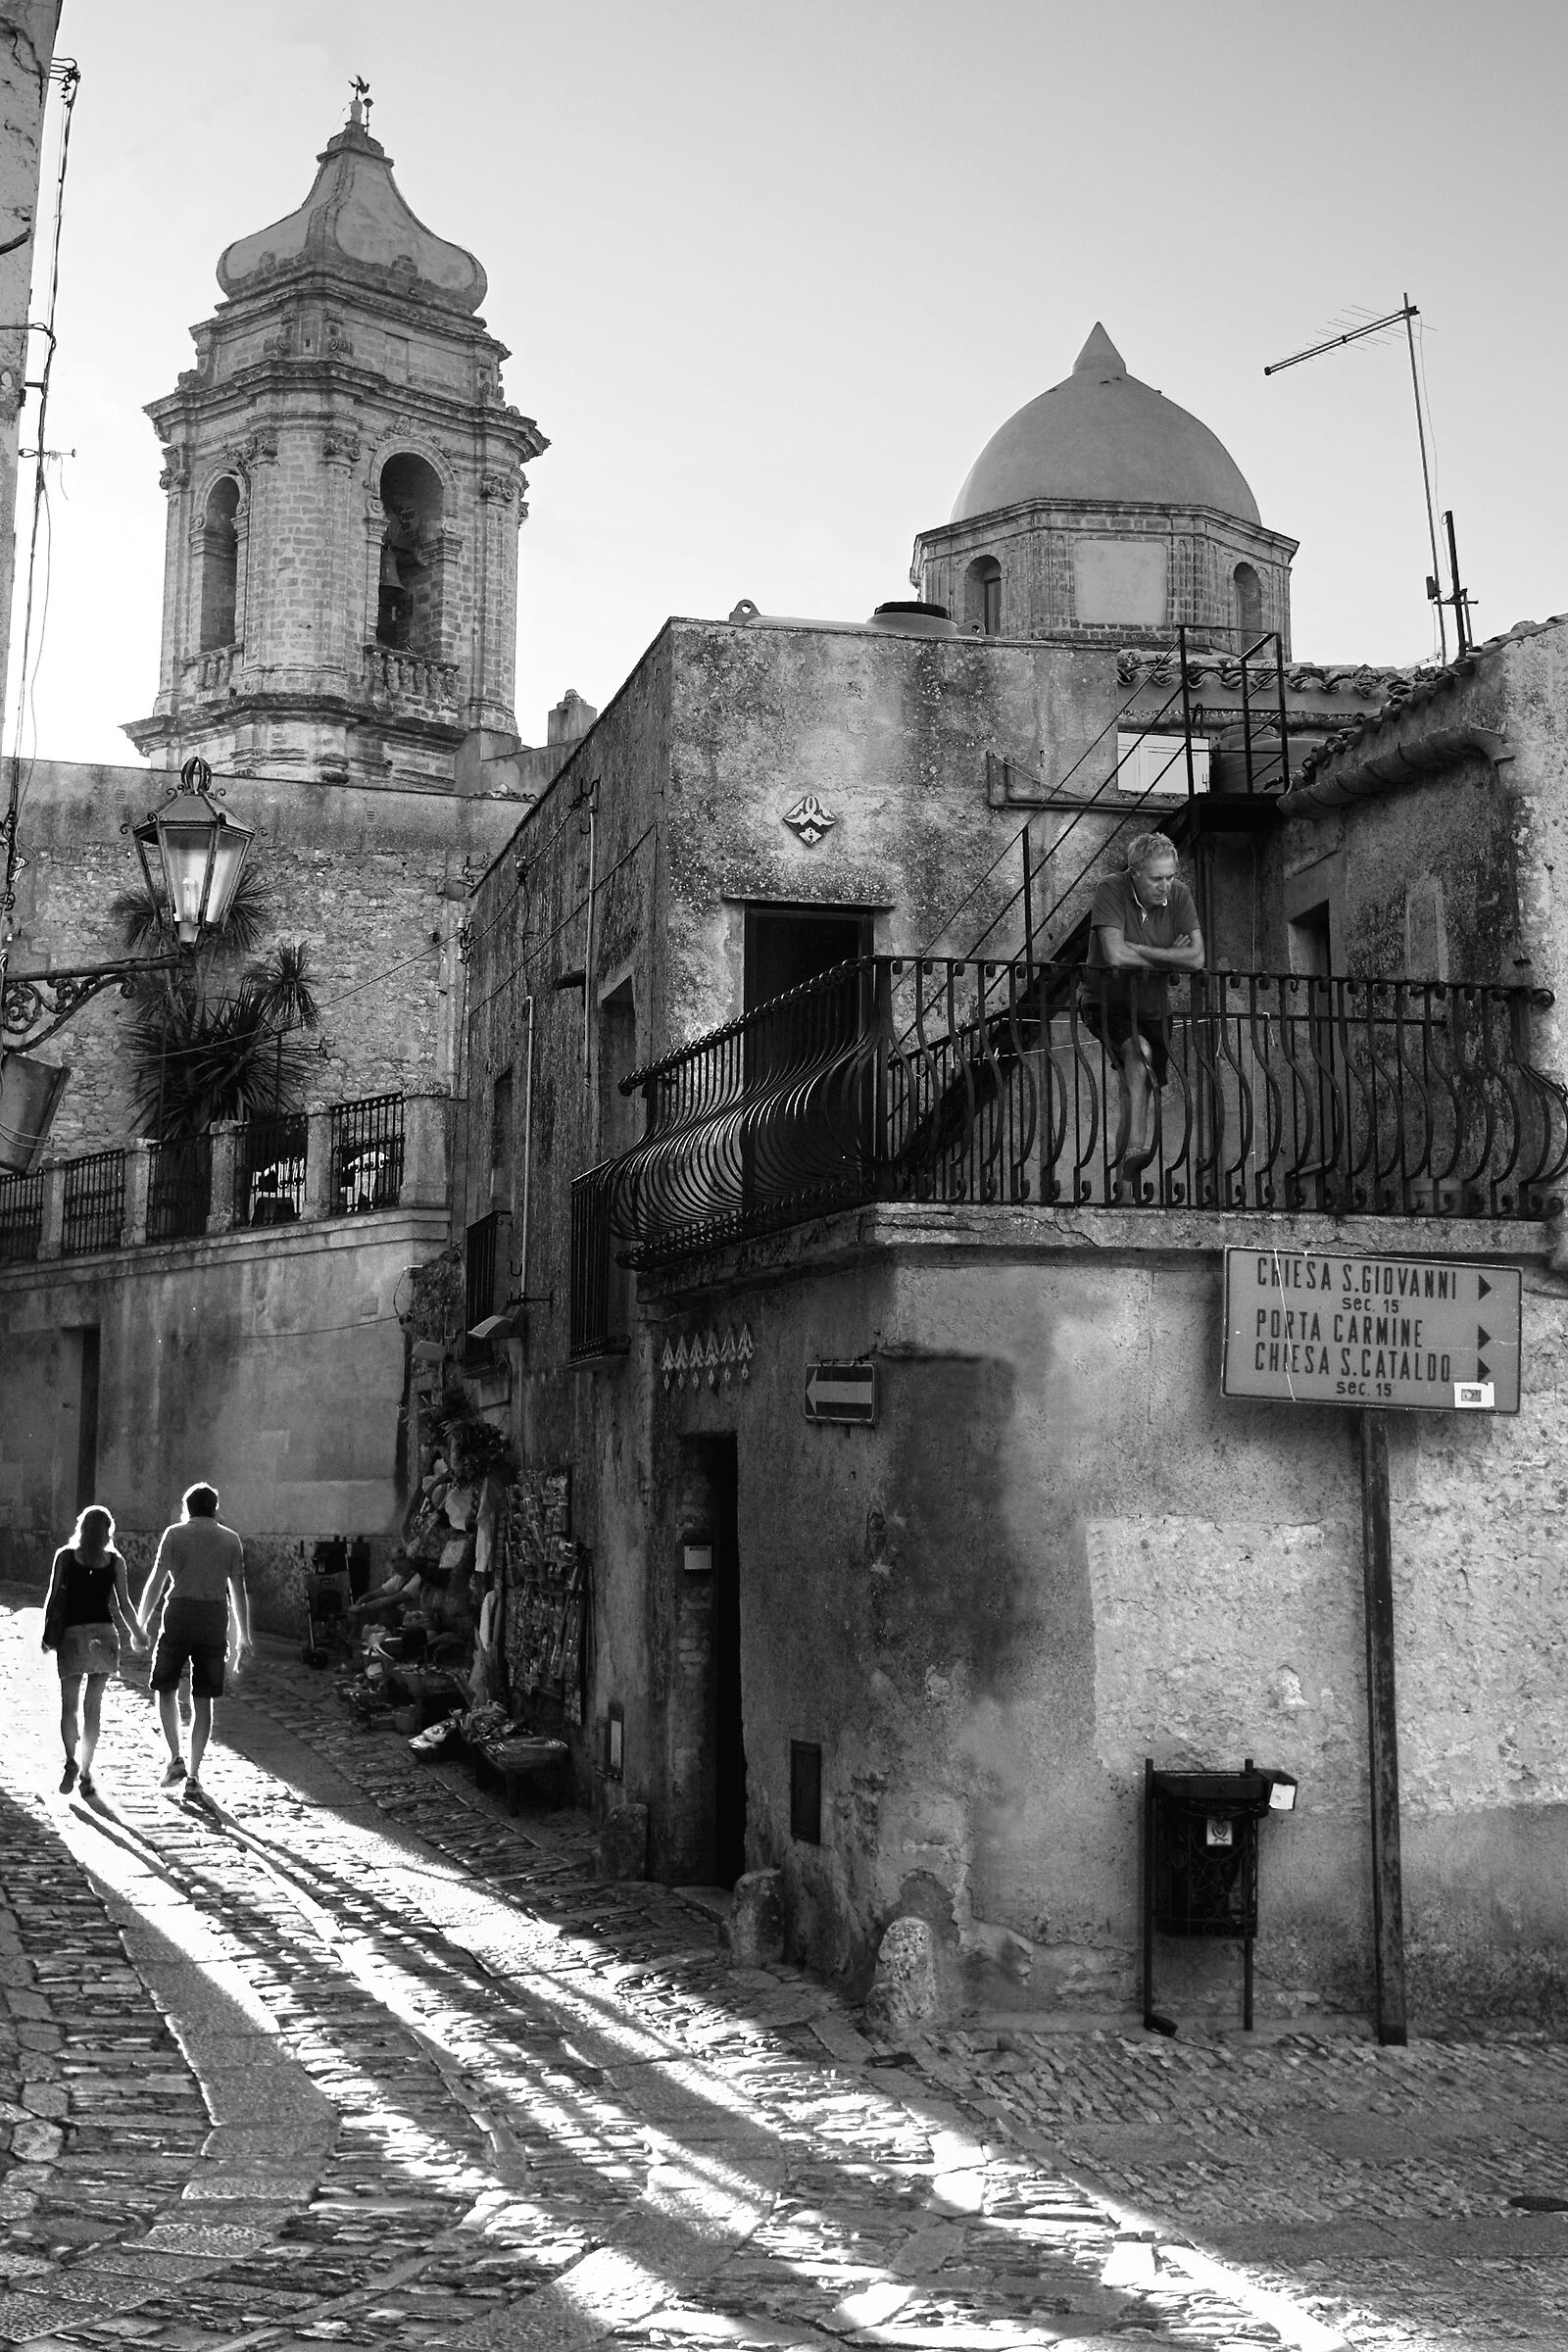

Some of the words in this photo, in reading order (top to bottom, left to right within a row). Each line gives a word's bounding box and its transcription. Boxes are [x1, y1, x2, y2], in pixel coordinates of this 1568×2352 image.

[1257, 1256, 1332, 1291] CHIESA
[1342, 1297, 1376, 1312] sec.
[1384, 1298, 1399, 1313] 15
[1256, 1308, 1321, 1342] PORTA
[1334, 1314, 1423, 1348] CARMINE
[1254, 1342, 1330, 1374] CHIESA
[1336, 1381, 1371, 1396] sec.
[1377, 1383, 1393, 1397] 15
